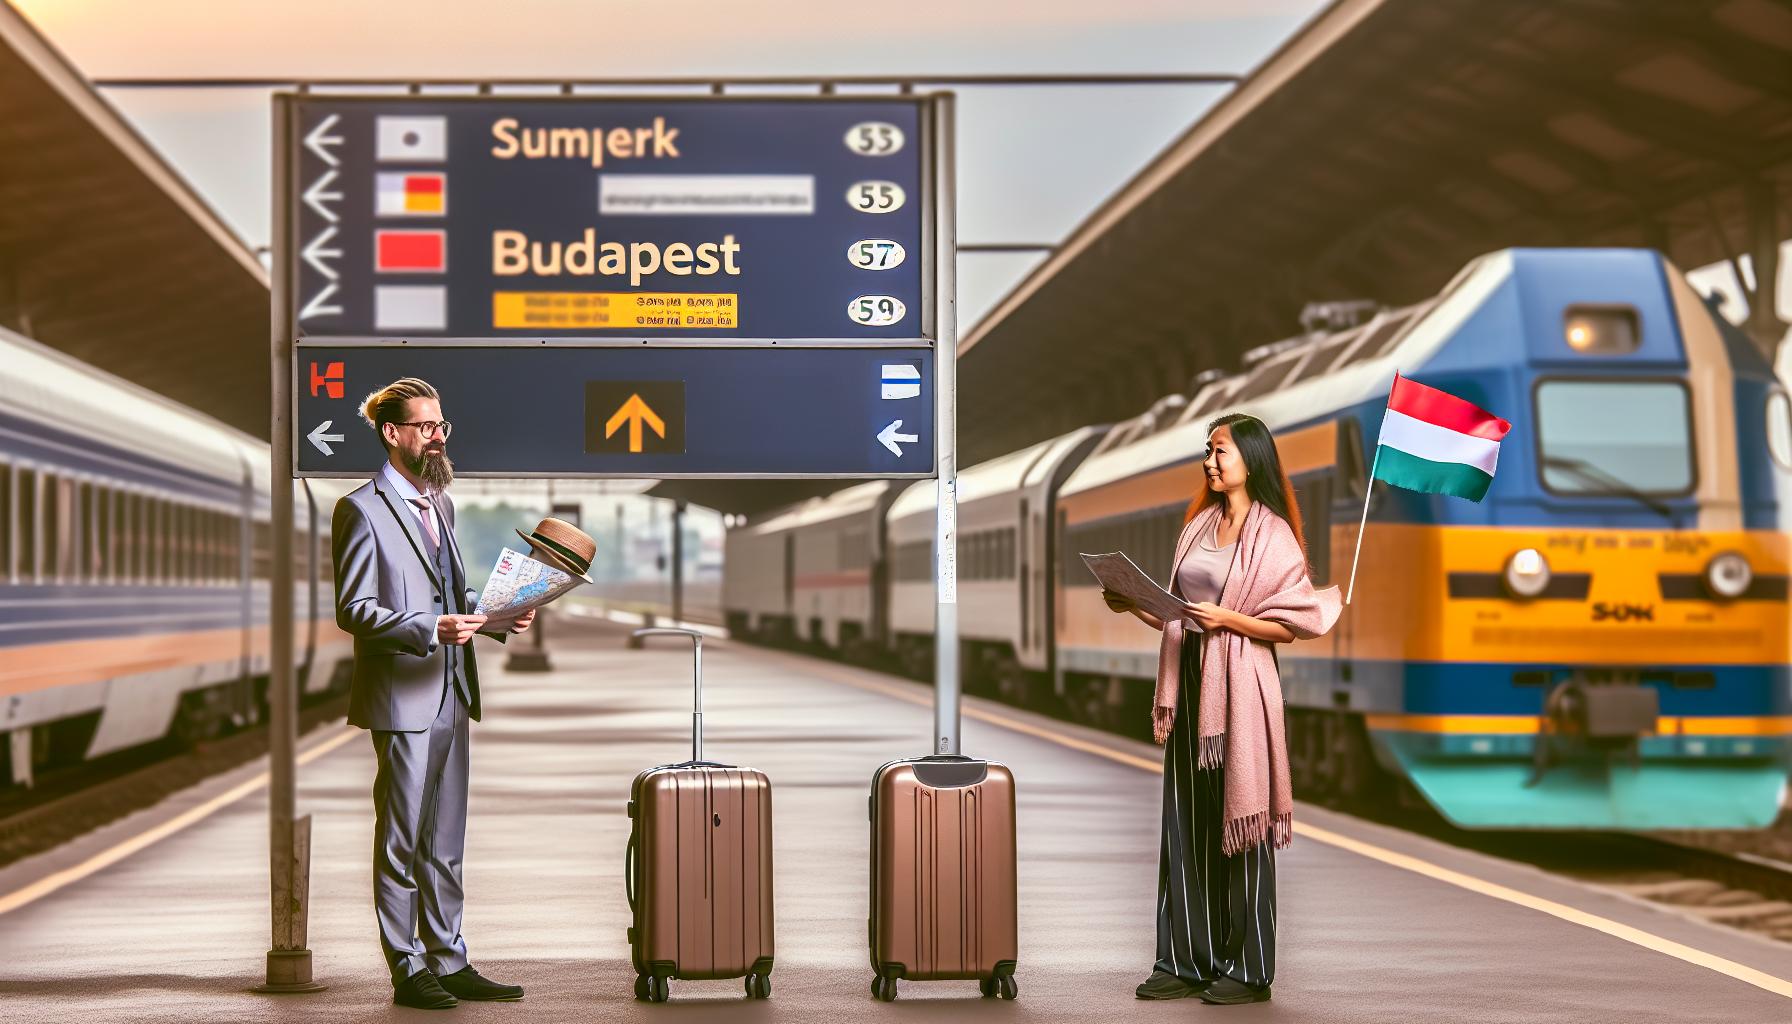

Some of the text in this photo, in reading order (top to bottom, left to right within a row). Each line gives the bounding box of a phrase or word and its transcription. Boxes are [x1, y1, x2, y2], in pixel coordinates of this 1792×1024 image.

[859, 185, 894, 209] 55
[493, 228, 741, 286] Budapest
[858, 243, 895, 266] 57
[858, 299, 894, 322] 59
